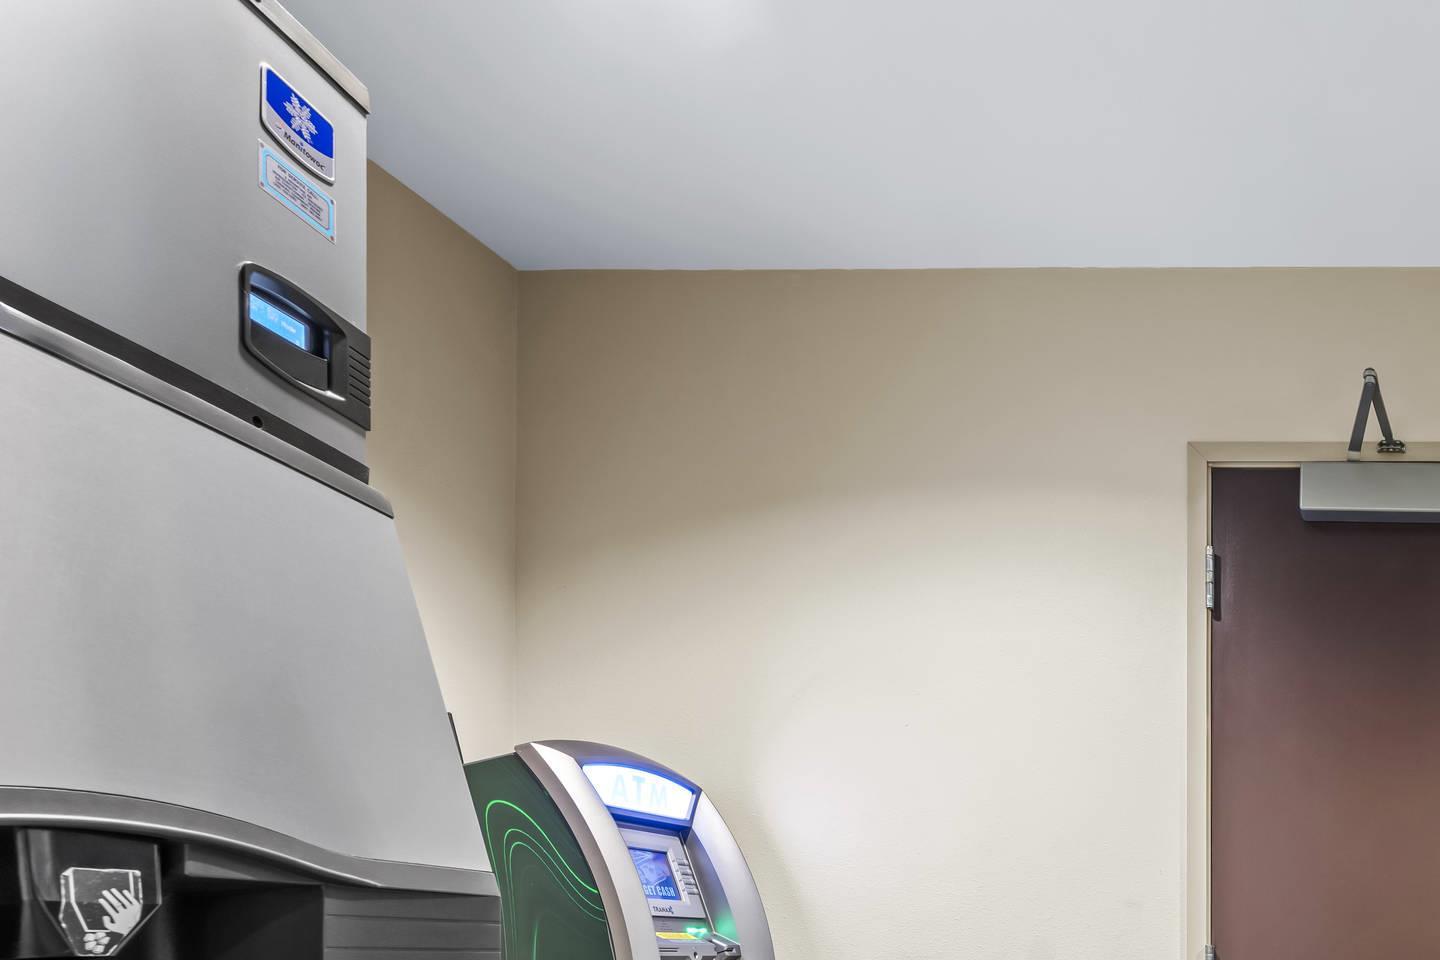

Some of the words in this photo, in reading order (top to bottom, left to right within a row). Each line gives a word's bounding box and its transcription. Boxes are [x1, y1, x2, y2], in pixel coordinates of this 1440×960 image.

[283, 131, 326, 172] Manitowoc
[612, 774, 668, 809] ATM
[657, 886, 676, 897] CASH
